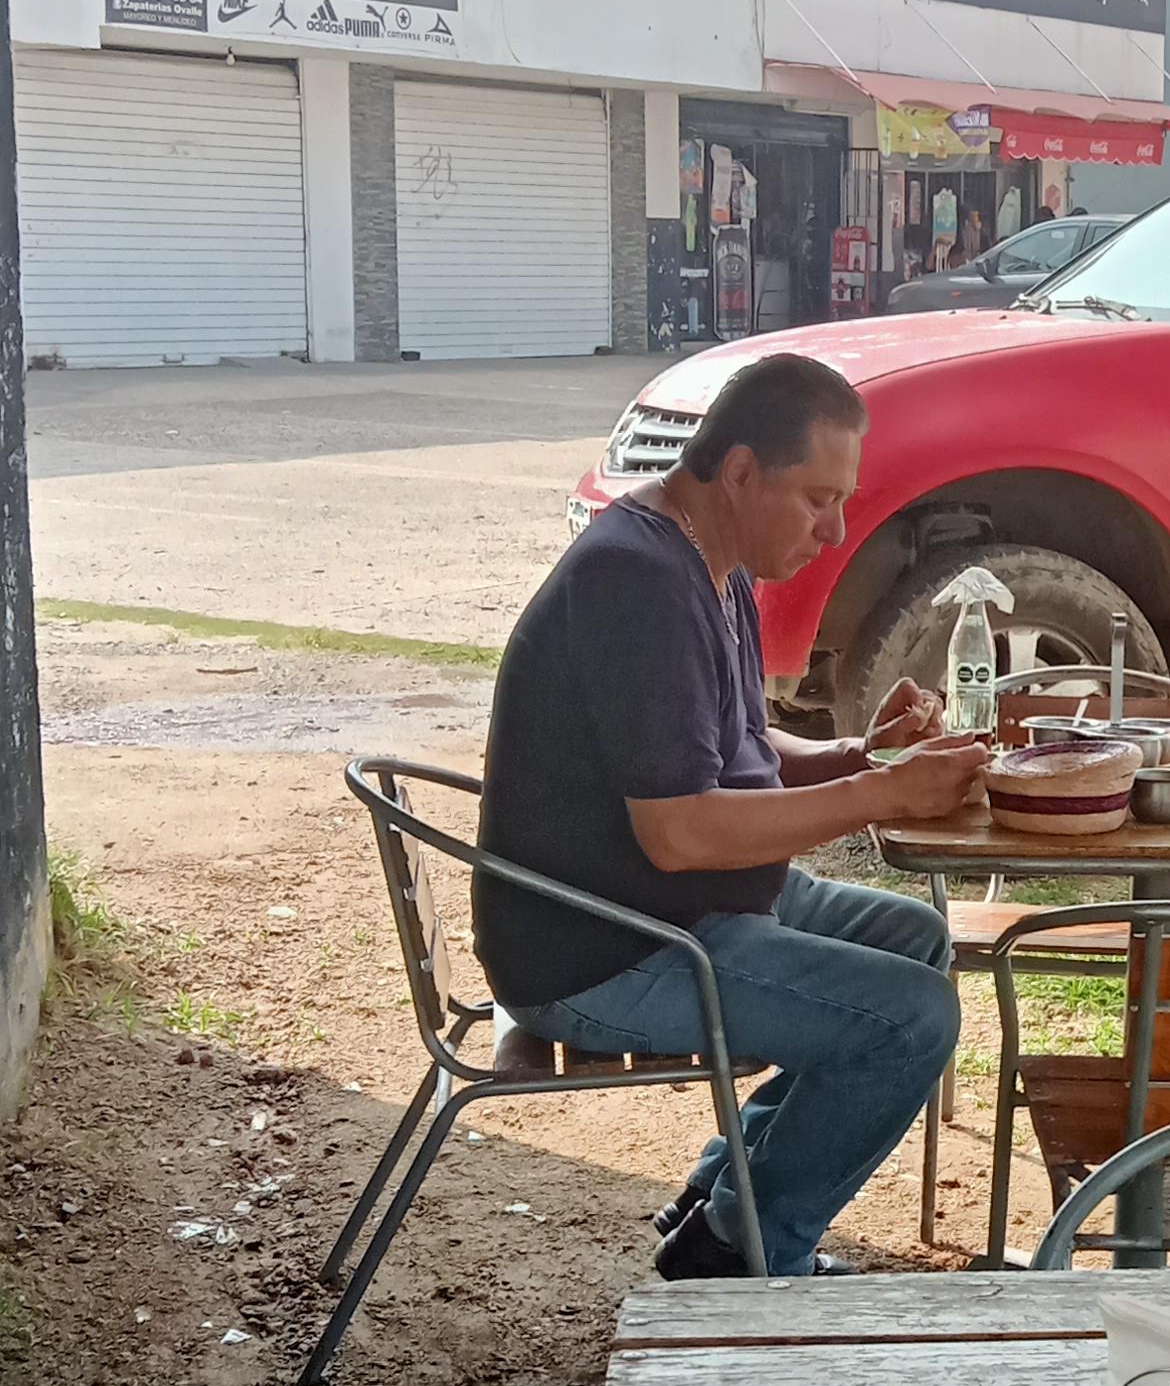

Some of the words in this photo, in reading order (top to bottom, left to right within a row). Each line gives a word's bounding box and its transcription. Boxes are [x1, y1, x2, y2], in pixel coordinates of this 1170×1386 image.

[122, 0, 172, 13] Zapaterias
[306, 20, 344, 35] adidas
[344, 18, 380, 38] PUMA
[424, 34, 456, 46] PIRMA
